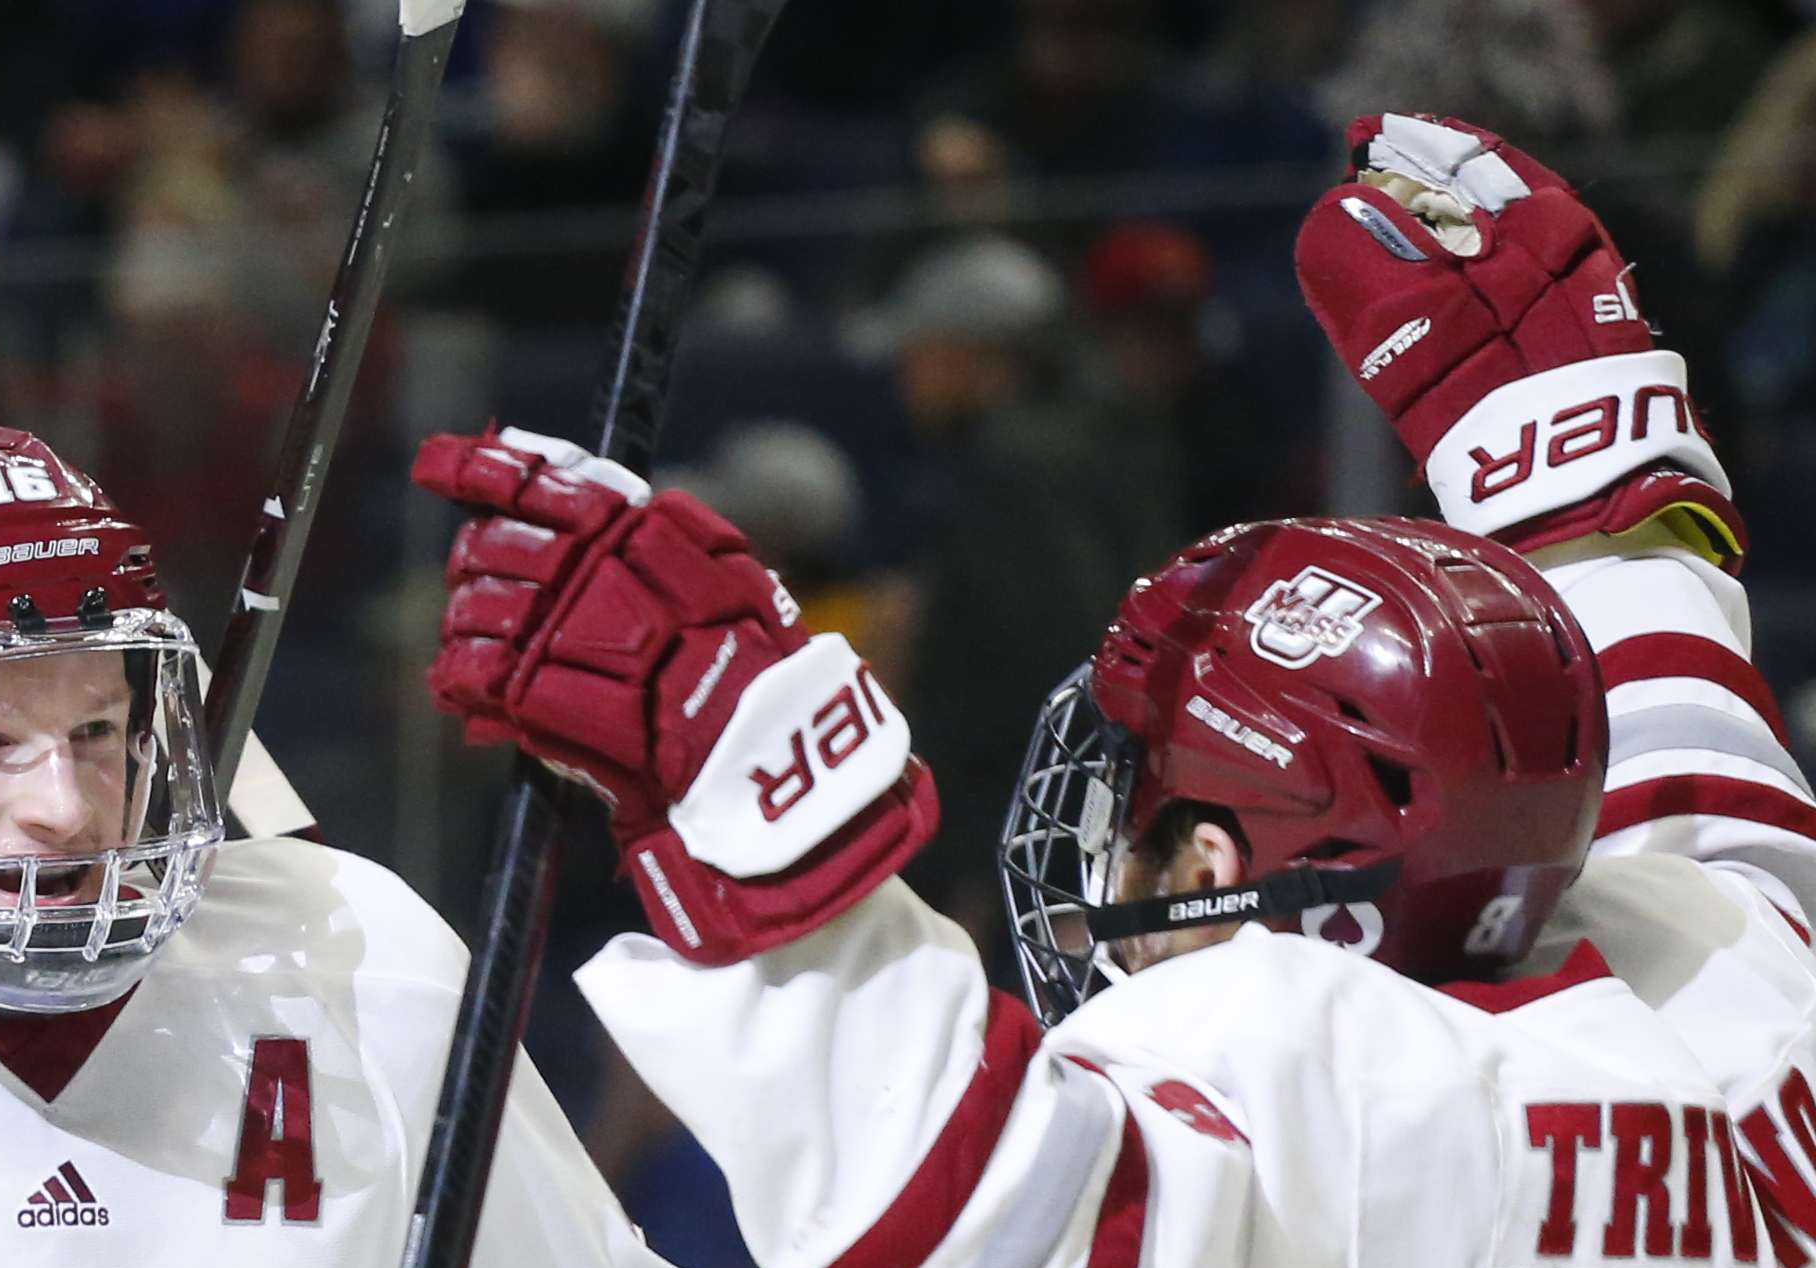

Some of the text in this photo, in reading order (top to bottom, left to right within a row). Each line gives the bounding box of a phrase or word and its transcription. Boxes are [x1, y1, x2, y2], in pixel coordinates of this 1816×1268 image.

[1469, 385, 1687, 503] UER
[1186, 695, 1294, 769] BAUER
[1169, 889, 1259, 921] BAUER
[224, 1037, 322, 1222] A
[17, 1203, 110, 1228] adidas
